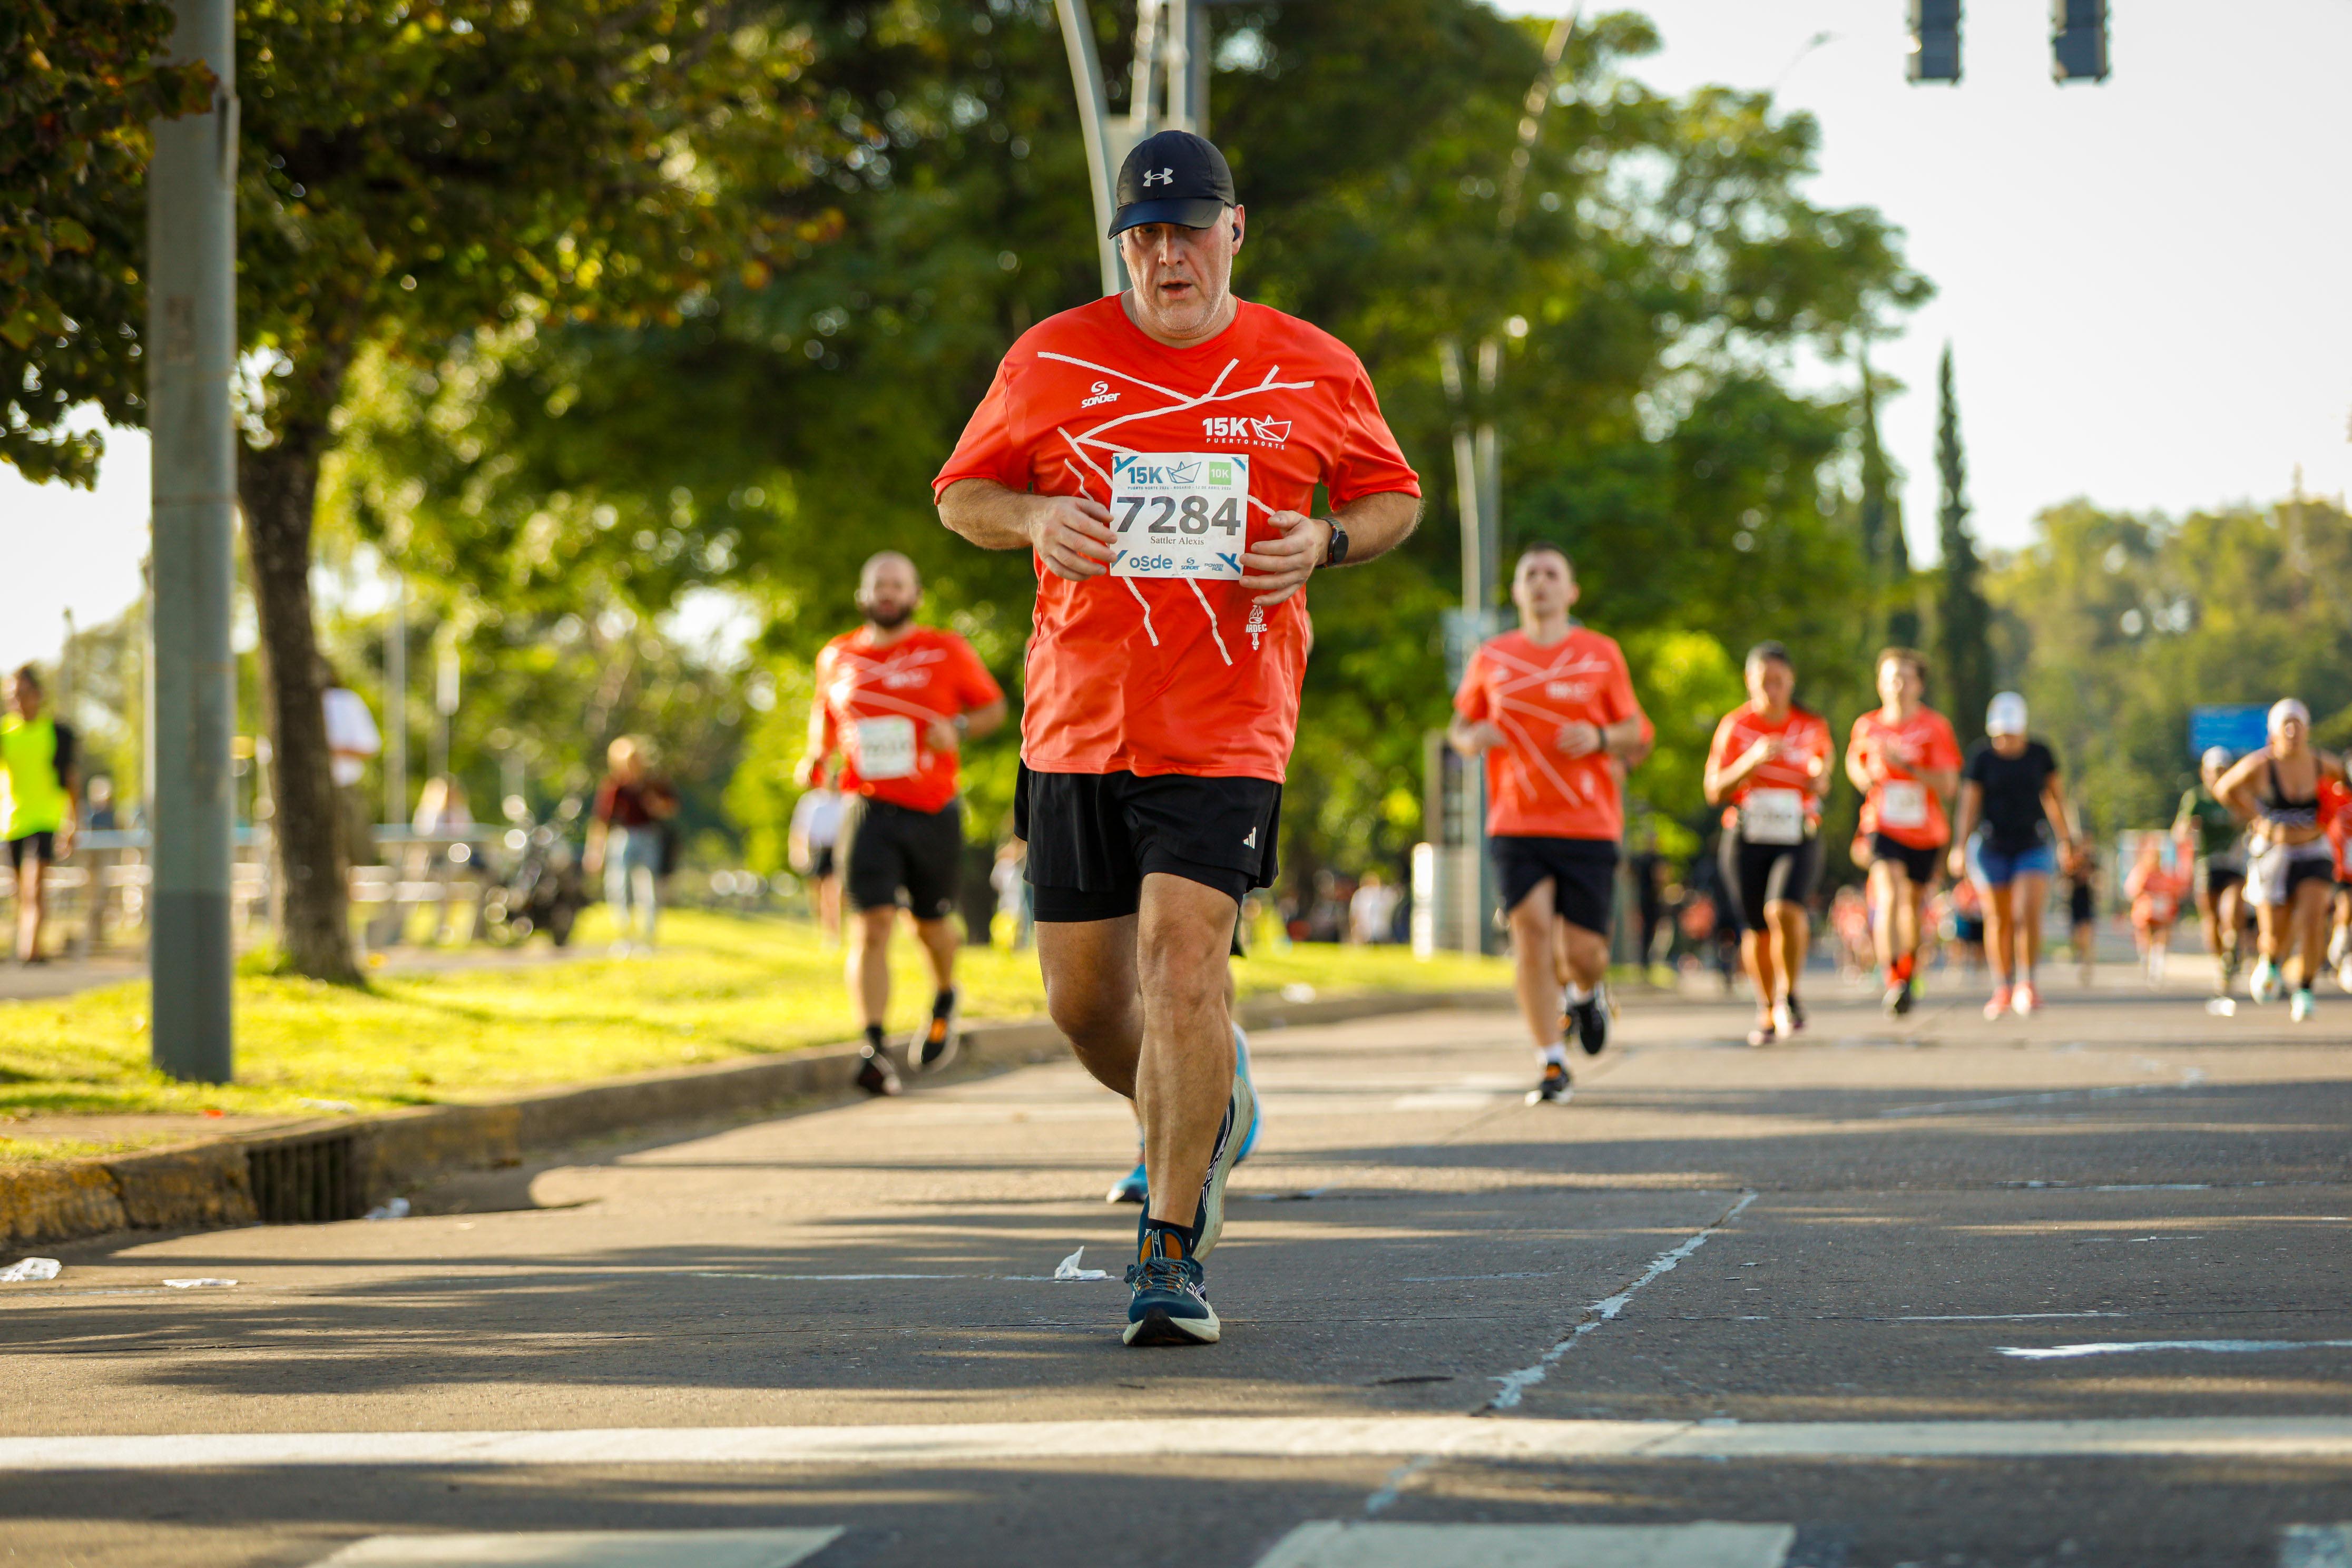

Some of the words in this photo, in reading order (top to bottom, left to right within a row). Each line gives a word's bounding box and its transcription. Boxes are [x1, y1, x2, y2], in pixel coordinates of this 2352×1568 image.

[1202, 417, 1249, 437] 15K
[1253, 439, 1285, 450] NORTE
[1127, 466, 1164, 484] 15K
[1211, 467, 1229, 478] 10K
[1116, 495, 1241, 536] 7284
[1150, 536, 1177, 544] Sattler
[1179, 537, 1204, 545] Alexis
[1129, 554, 1173, 569] osde
[1246, 624, 1268, 633] ARDEC
